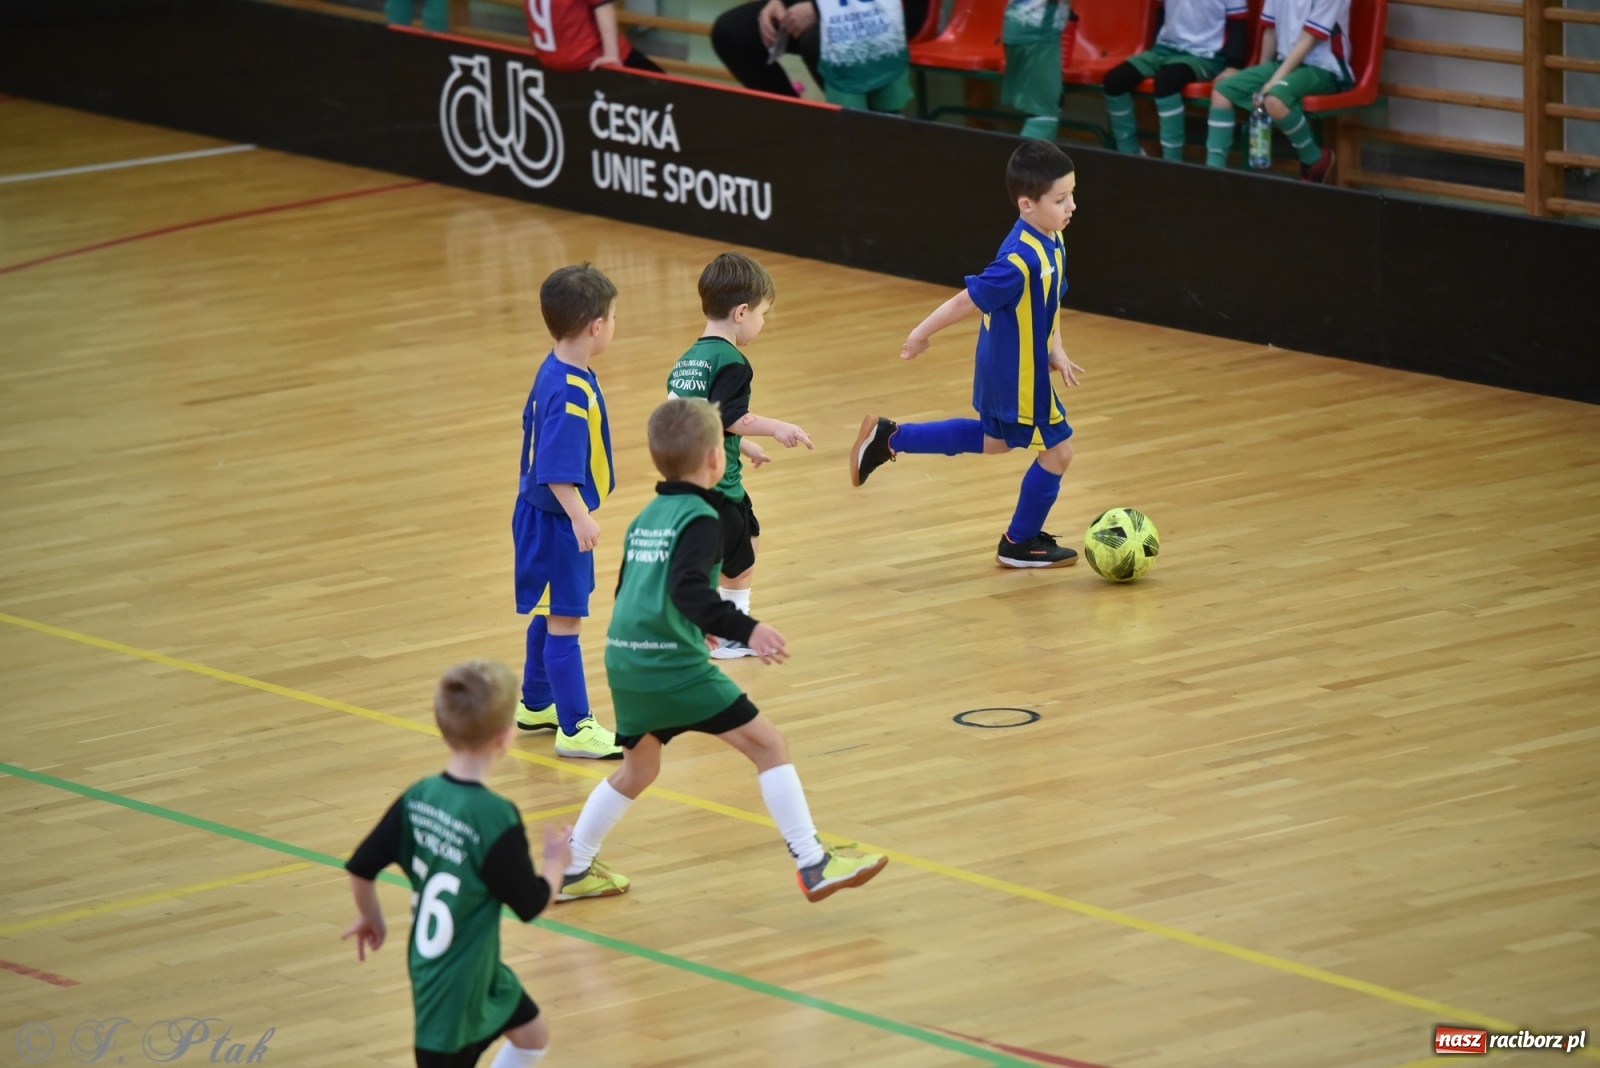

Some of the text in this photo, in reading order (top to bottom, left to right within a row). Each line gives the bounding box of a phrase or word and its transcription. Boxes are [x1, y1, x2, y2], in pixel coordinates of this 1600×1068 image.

[589, 90, 681, 153] ČESKÁ
[591, 150, 773, 221] UNIE SPORTU
